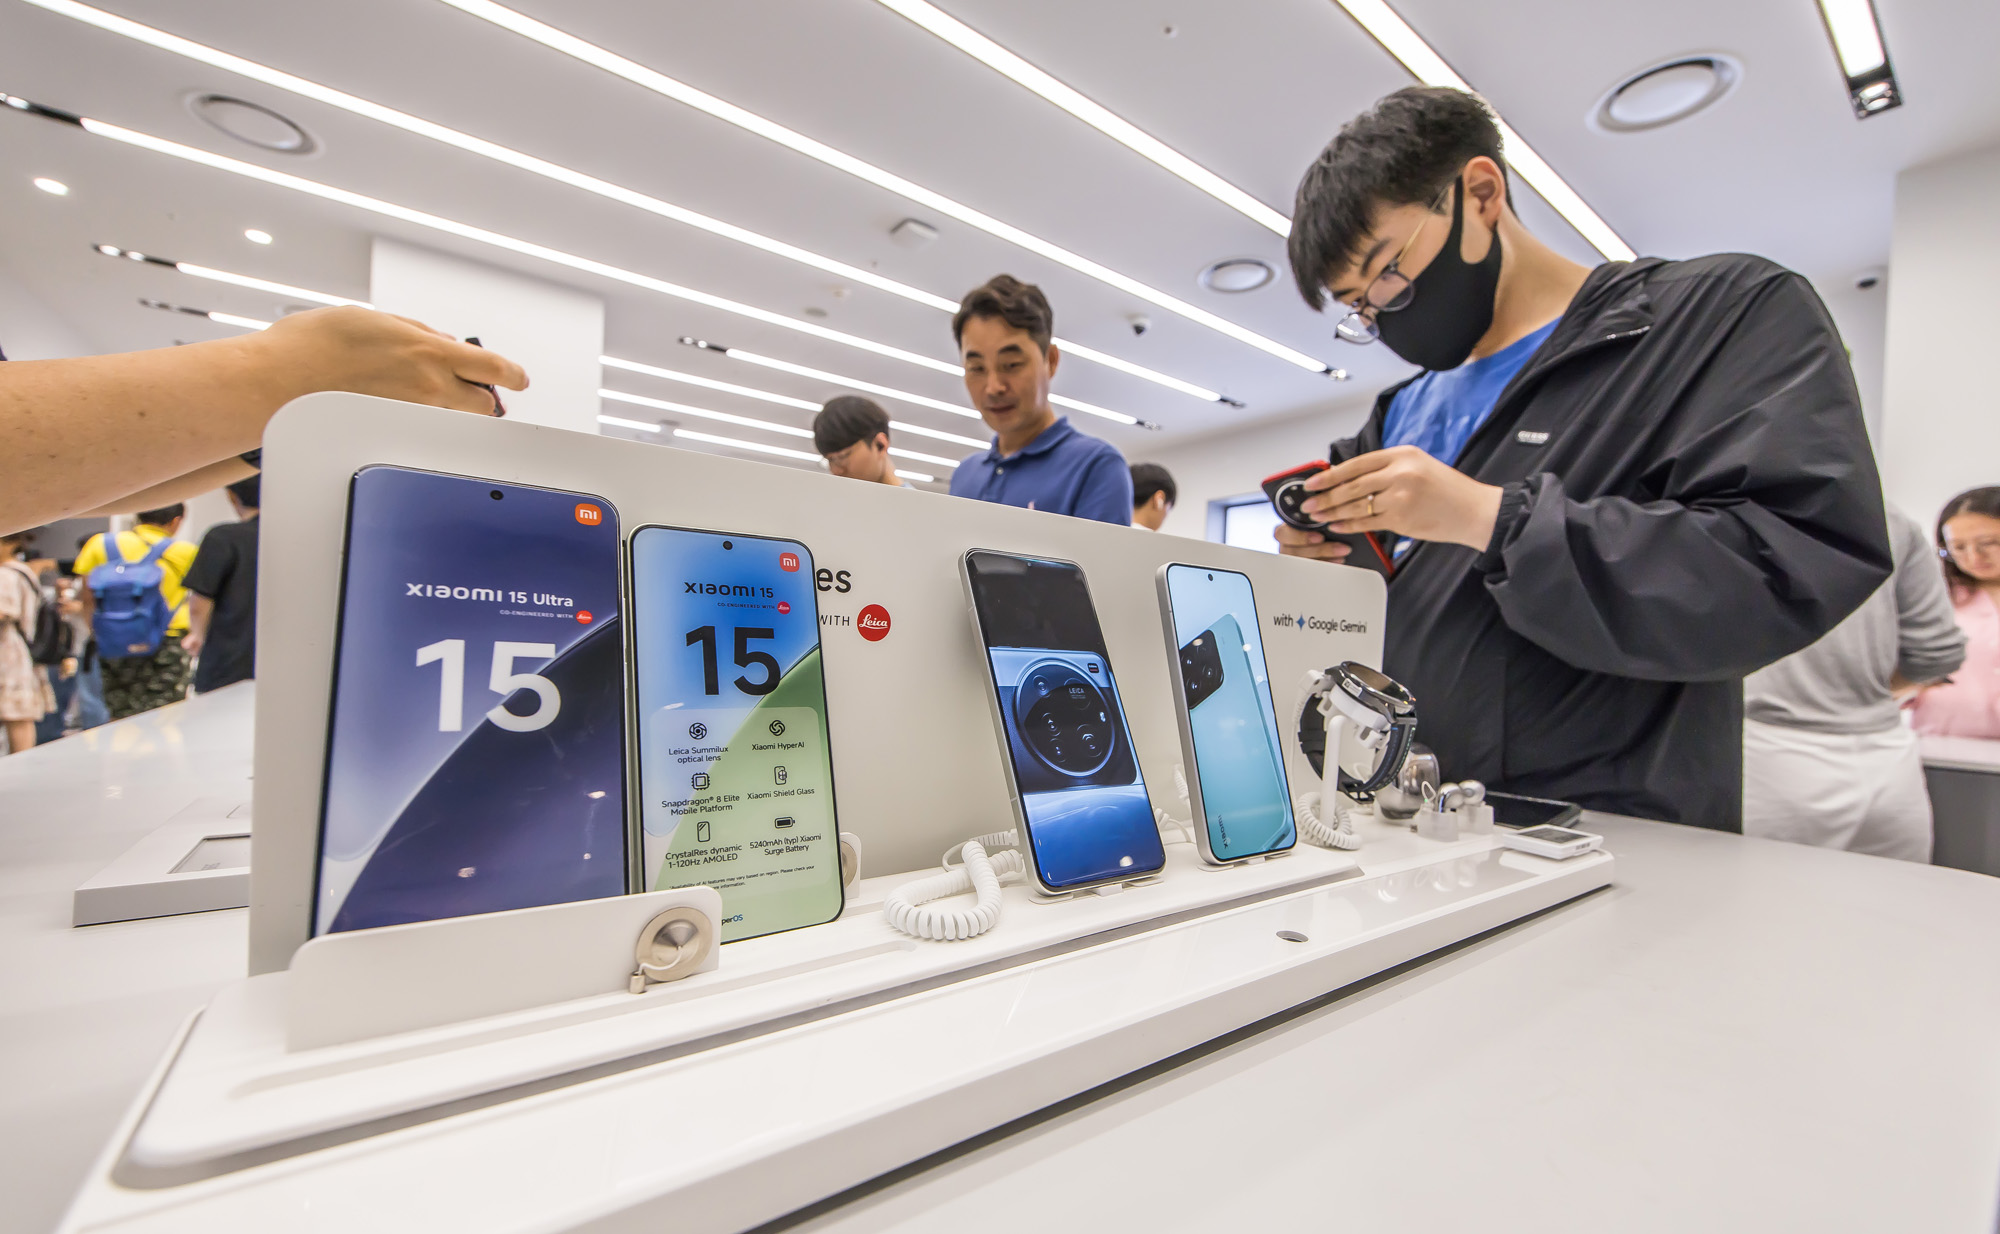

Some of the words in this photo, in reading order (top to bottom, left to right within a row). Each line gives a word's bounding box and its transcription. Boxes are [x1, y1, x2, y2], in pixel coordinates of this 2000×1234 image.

[405, 583, 502, 602] xiaomi
[508, 591, 528, 604] 15
[533, 593, 574, 607] Ultra
[684, 582, 755, 597] xiaomi
[759, 587, 774, 598] 15
[499, 609, 555, 618] CO-ENGINEERED
[858, 613, 889, 630] Leica
[1273, 613, 1294, 627] with
[1308, 616, 1338, 634] Google
[1340, 619, 1368, 634] Gemini
[685, 625, 781, 696] 15
[416, 638, 561, 733] 15
[668, 747, 690, 756] Leica
[691, 745, 729, 755] Summilux
[751, 743, 776, 751] Xiaomi
[777, 741, 805, 750] HyperAI
[677, 755, 704, 764] optical
[705, 754, 721, 762] lens
[747, 791, 772, 800] Xiaomi
[773, 789, 795, 797] Shield
[797, 787, 815, 796] Glass
[670, 808, 698, 816] Mobile
[700, 804, 733, 813] Platform
[749, 838, 783, 849] 5240mAh
[784, 836, 799, 845] (typ)
[800, 833, 822, 842] Xiaomi
[665, 847, 708, 860] CrystalRes
[709, 844, 742, 854] dynamic
[764, 848, 785, 856] Surge
[785, 844, 809, 853] Battery
[668, 858, 700, 868] 1-120Hz
[702, 853, 738, 864] AMOLED
